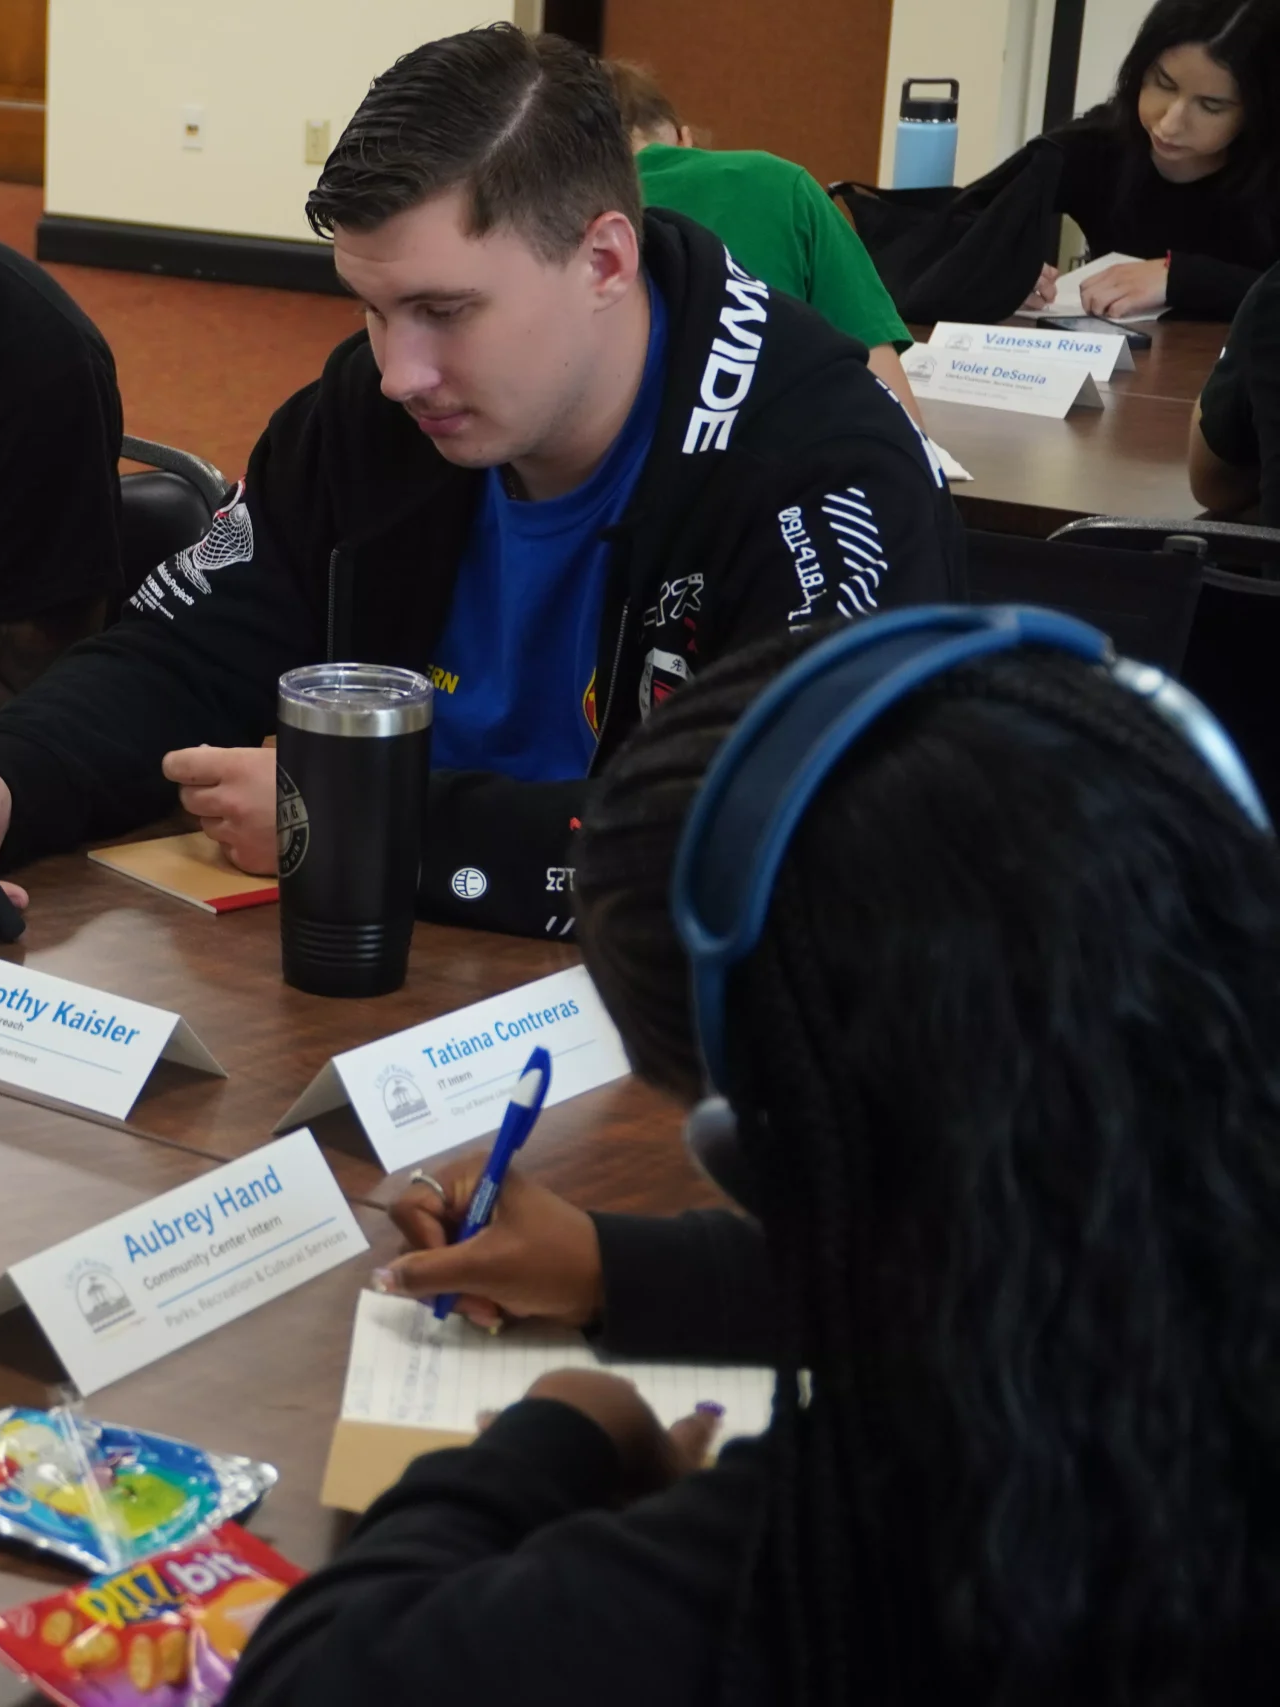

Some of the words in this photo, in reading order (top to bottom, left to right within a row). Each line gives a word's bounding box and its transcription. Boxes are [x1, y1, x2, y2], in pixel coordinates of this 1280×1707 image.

[950, 359, 989, 376] Violet
[991, 365, 1048, 385] DeSonia
[983, 333, 1051, 350] Vanessa
[1056, 338, 1103, 354] Rivas
[52, 1000, 140, 1046] Kaisler
[422, 1031, 494, 1069] Tatiana
[494, 999, 579, 1042] Contreras
[436, 1078, 448, 1091] IT
[448, 1071, 473, 1087] Intern
[123, 1203, 215, 1264] Aubrey
[213, 1164, 284, 1218] Hand
[142, 1251, 211, 1291] Community
[209, 1231, 247, 1259] Center
[247, 1214, 283, 1242] Intern
[198, 1270, 255, 1312] Recreation
[255, 1270, 266, 1283] &
[262, 1251, 305, 1280] Cultural
[304, 1229, 348, 1260] Services
